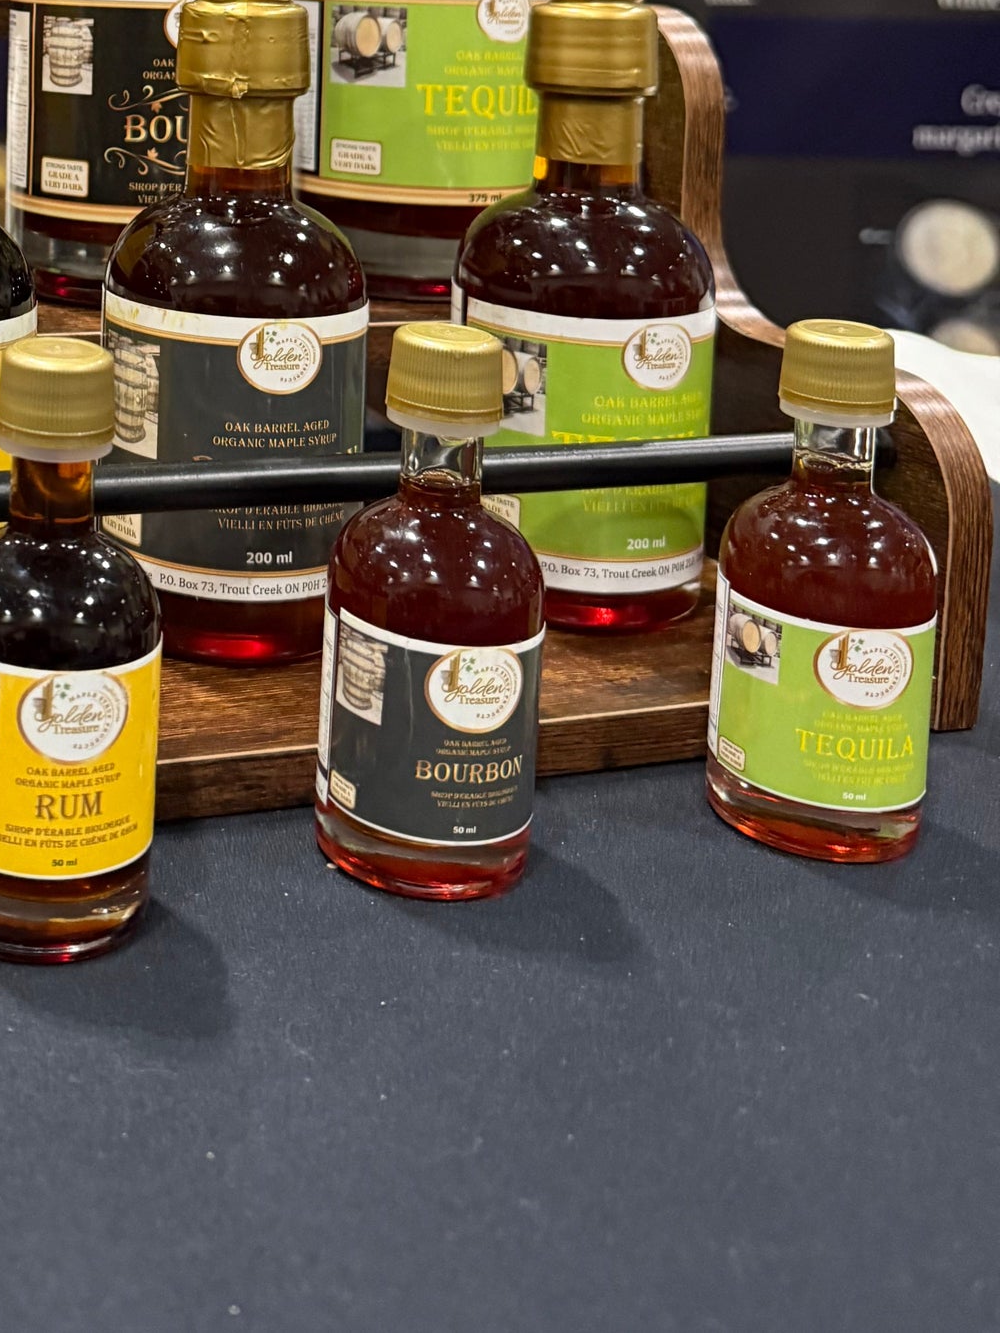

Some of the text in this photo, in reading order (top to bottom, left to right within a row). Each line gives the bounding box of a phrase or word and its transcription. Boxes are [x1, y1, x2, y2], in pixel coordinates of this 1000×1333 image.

[152, 57, 176, 68] OAK
[415, 83, 537, 121] TEQUIL
[128, 181, 159, 192] SIROP
[263, 362, 301, 371] Treasure
[630, 393, 678, 409] BARREL
[581, 412, 643, 426] ORGANIC
[224, 419, 330, 434] OAK BARREL AGED
[212, 432, 338, 449] ORGANIC MAPLE SYRUP
[217, 515, 317, 531] VIELLI EN DE
[626, 536, 666, 550] 200 ml
[245, 550, 294, 565] 200 ml
[560, 563, 670, 580] Box 73, Trout Creek ON
[159, 573, 301, 596] P.O. Box 73, Trout Creek ON
[846, 673, 890, 684] Treasure
[457, 694, 501, 705] Treasure
[51, 722, 100, 735] Treasure
[795, 727, 915, 763] TEQUILA
[26, 762, 116, 778] OAK BARREL AGED
[414, 755, 524, 784] BOURBON
[14, 772, 122, 789] ORGANIC MAPLE SYRUP
[842, 791, 867, 802] 50 ml
[34, 790, 104, 821] RUM
[4, 823, 34, 837] SIROP
[452, 824, 478, 835] 50 ml
[65, 837, 79, 848] DE
[51, 857, 79, 868] 50 ml
